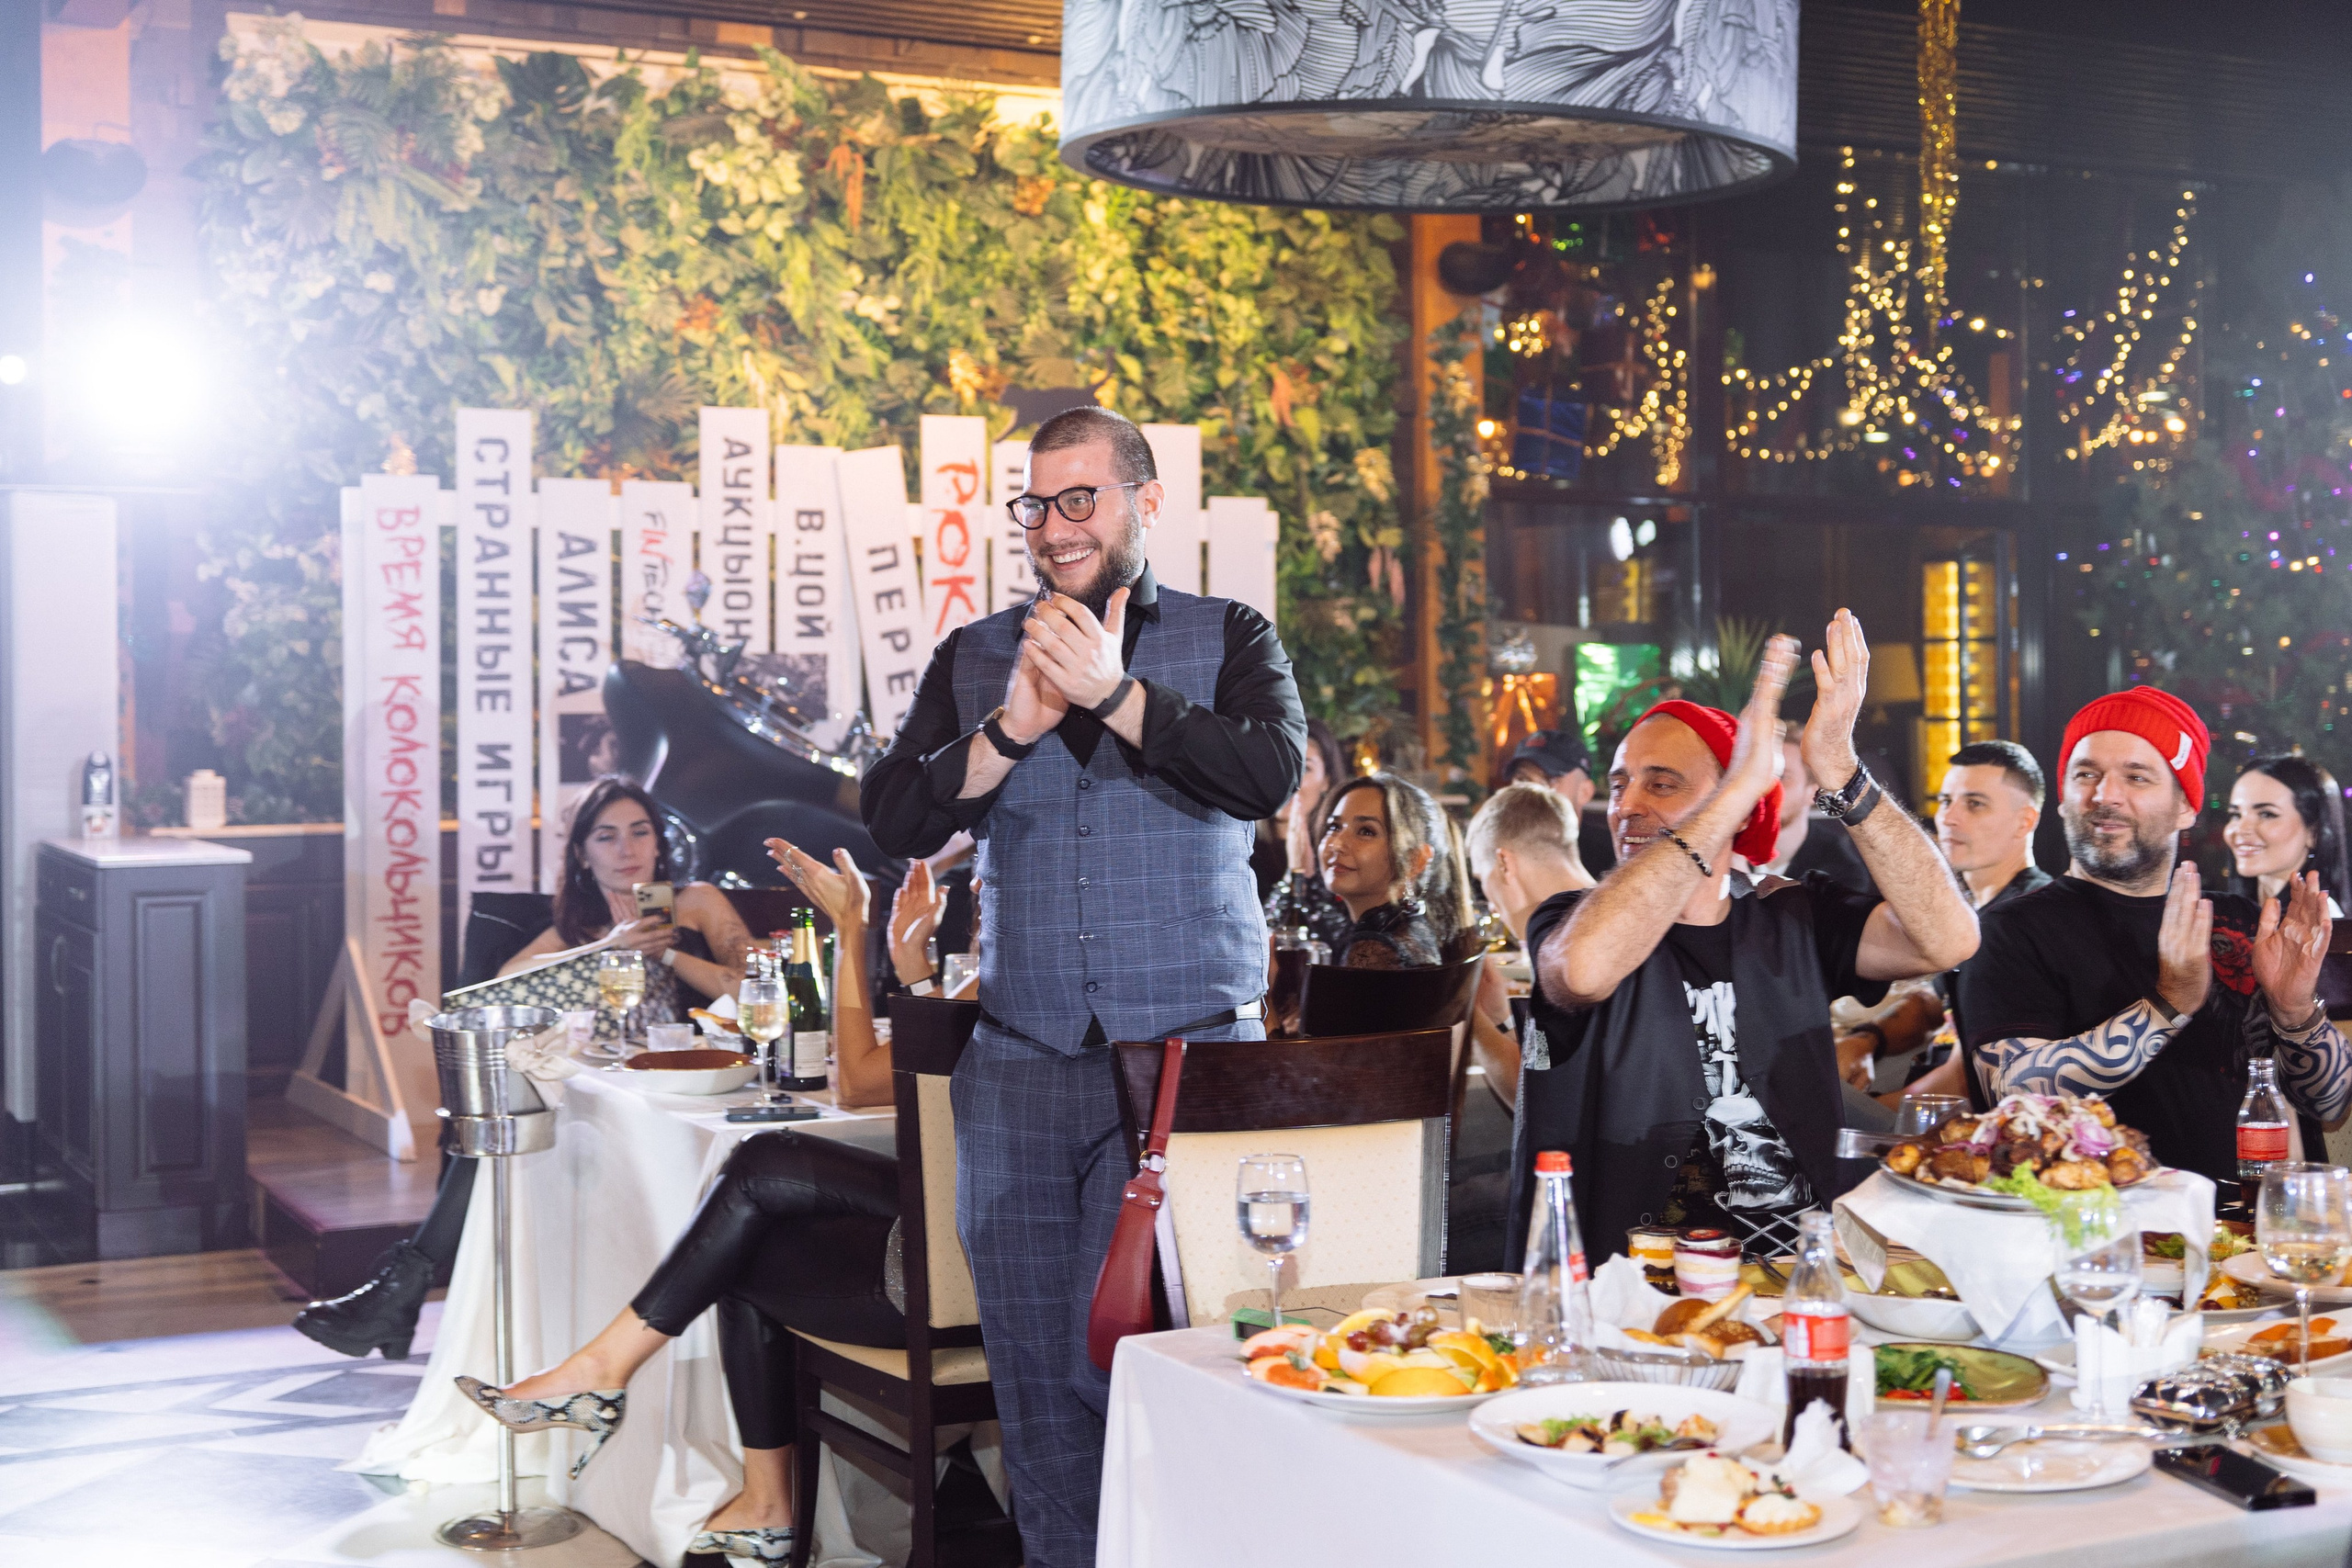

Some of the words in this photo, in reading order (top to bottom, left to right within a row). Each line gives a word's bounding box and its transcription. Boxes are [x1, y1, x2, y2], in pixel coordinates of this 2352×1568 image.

[377, 505, 427, 649] ВРЕМЯ
[475, 437, 513, 713] СТРАННЫЕ
[558, 531, 598, 697] АЛИСА
[716, 437, 752, 640] АУКЦЫОН
[787, 509, 831, 638] В.ЦОЙ
[931, 458, 980, 637] РОК
[868, 544, 917, 729] ПЕРЕ
[377, 675, 428, 1037] КОЛОКОЛЬЧИКОВ
[476, 743, 513, 883] ИГРЫ
